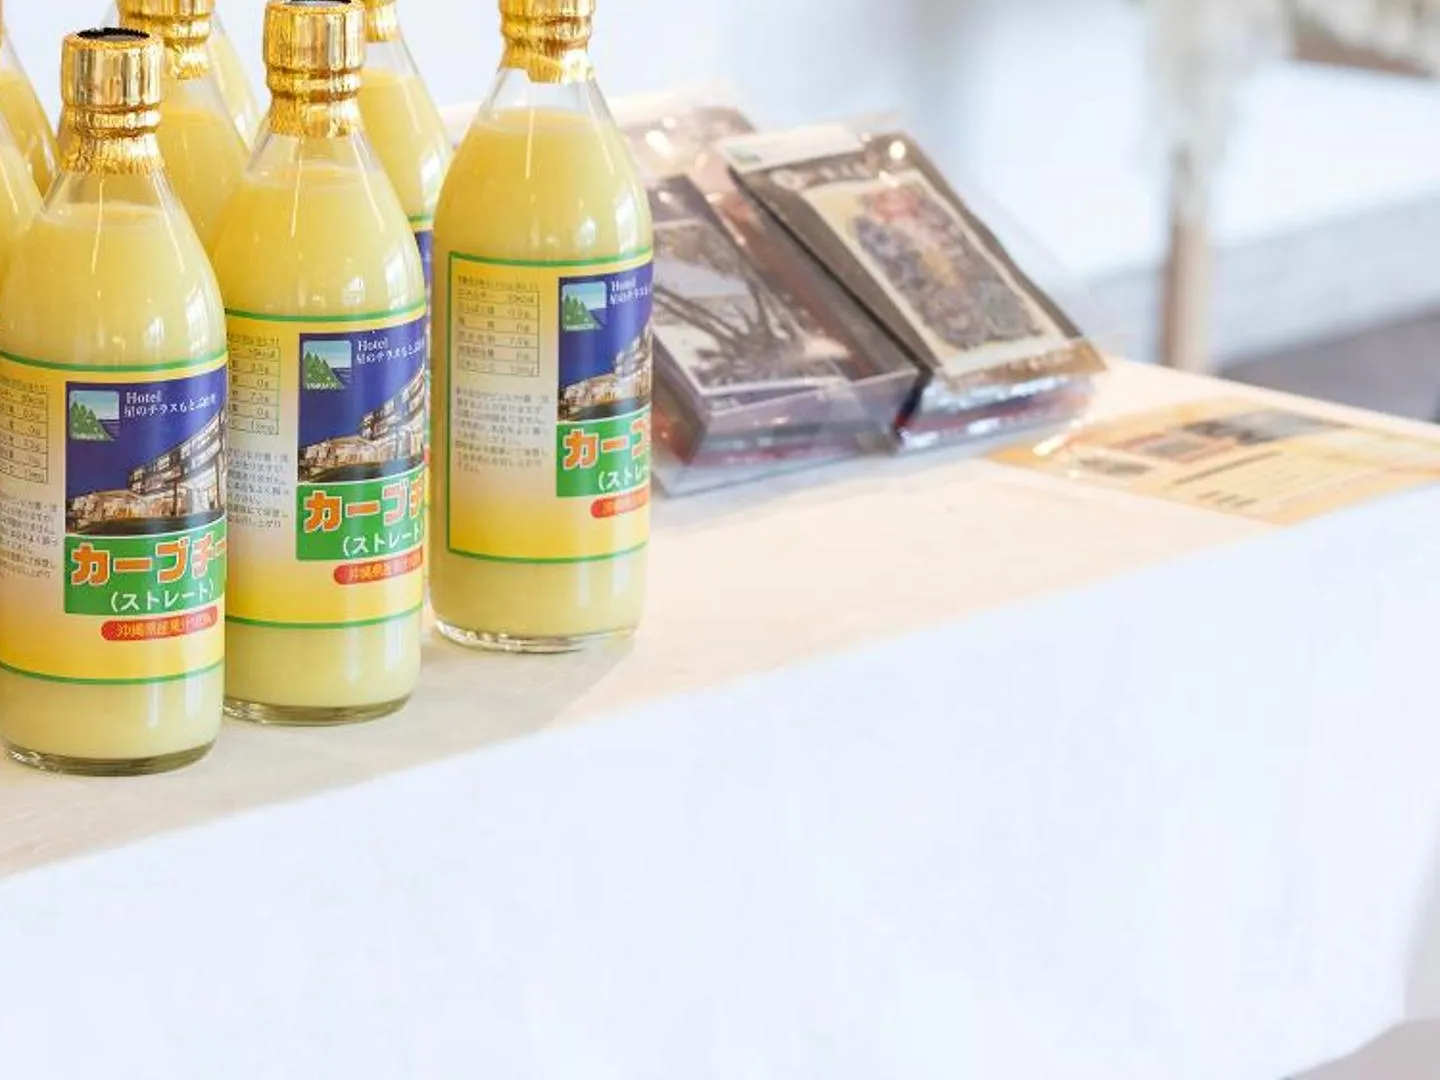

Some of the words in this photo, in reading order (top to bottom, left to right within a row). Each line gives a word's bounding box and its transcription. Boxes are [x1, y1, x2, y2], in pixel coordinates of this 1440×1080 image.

[358, 337, 388, 352] Hotel
[125, 390, 162, 404] Hotel
[111, 579, 214, 612] (ストレート)
